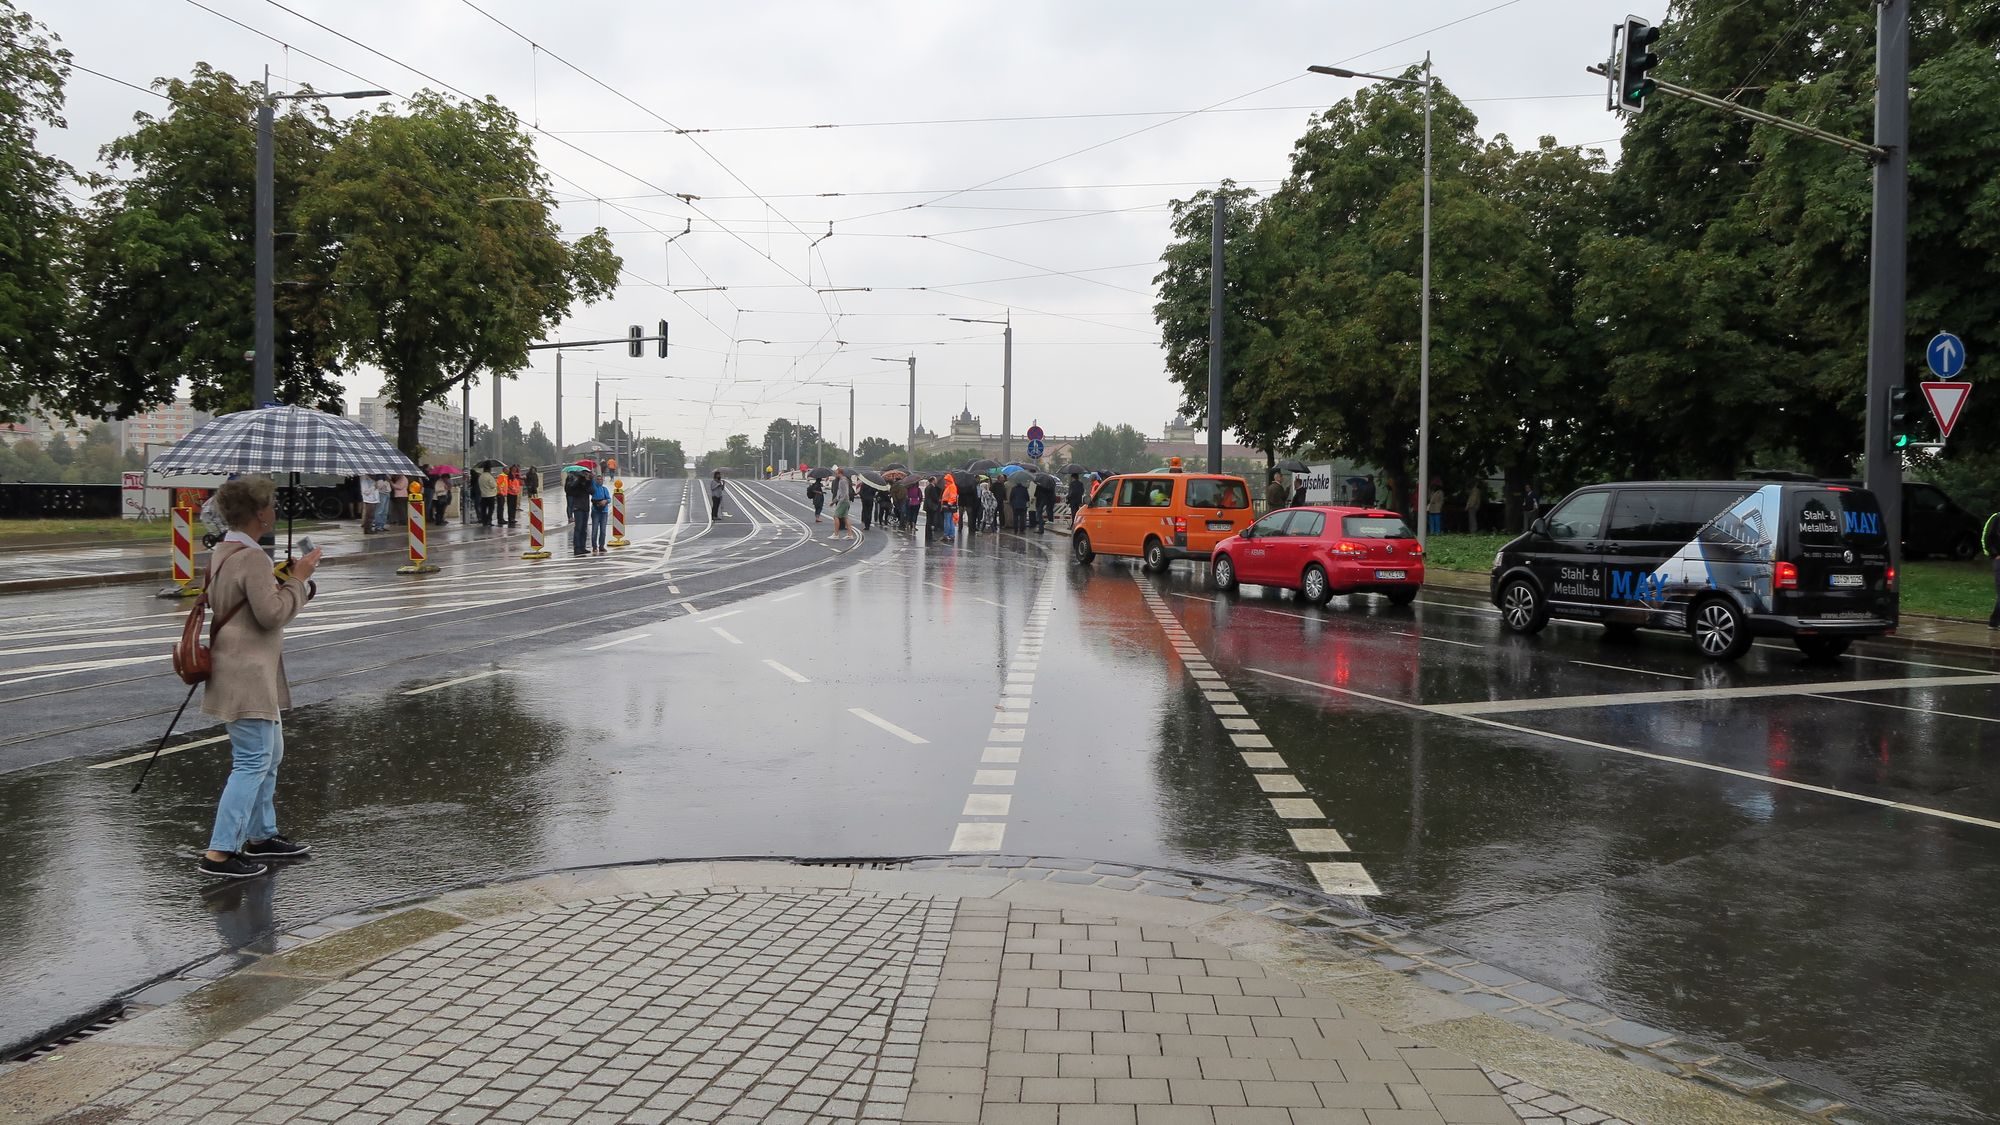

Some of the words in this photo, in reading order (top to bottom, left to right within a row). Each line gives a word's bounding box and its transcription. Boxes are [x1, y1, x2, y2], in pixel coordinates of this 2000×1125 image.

[1803, 510, 1828, 520] Stahl-
[1830, 511, 1836, 520] &
[1844, 511, 1878, 534] MAY
[1799, 523, 1838, 533] Metallbau
[1561, 567, 1589, 580] Stahl-
[1592, 570, 1600, 582] &
[1554, 582, 1600, 597] Metallbau
[1611, 570, 1669, 602] MAY
